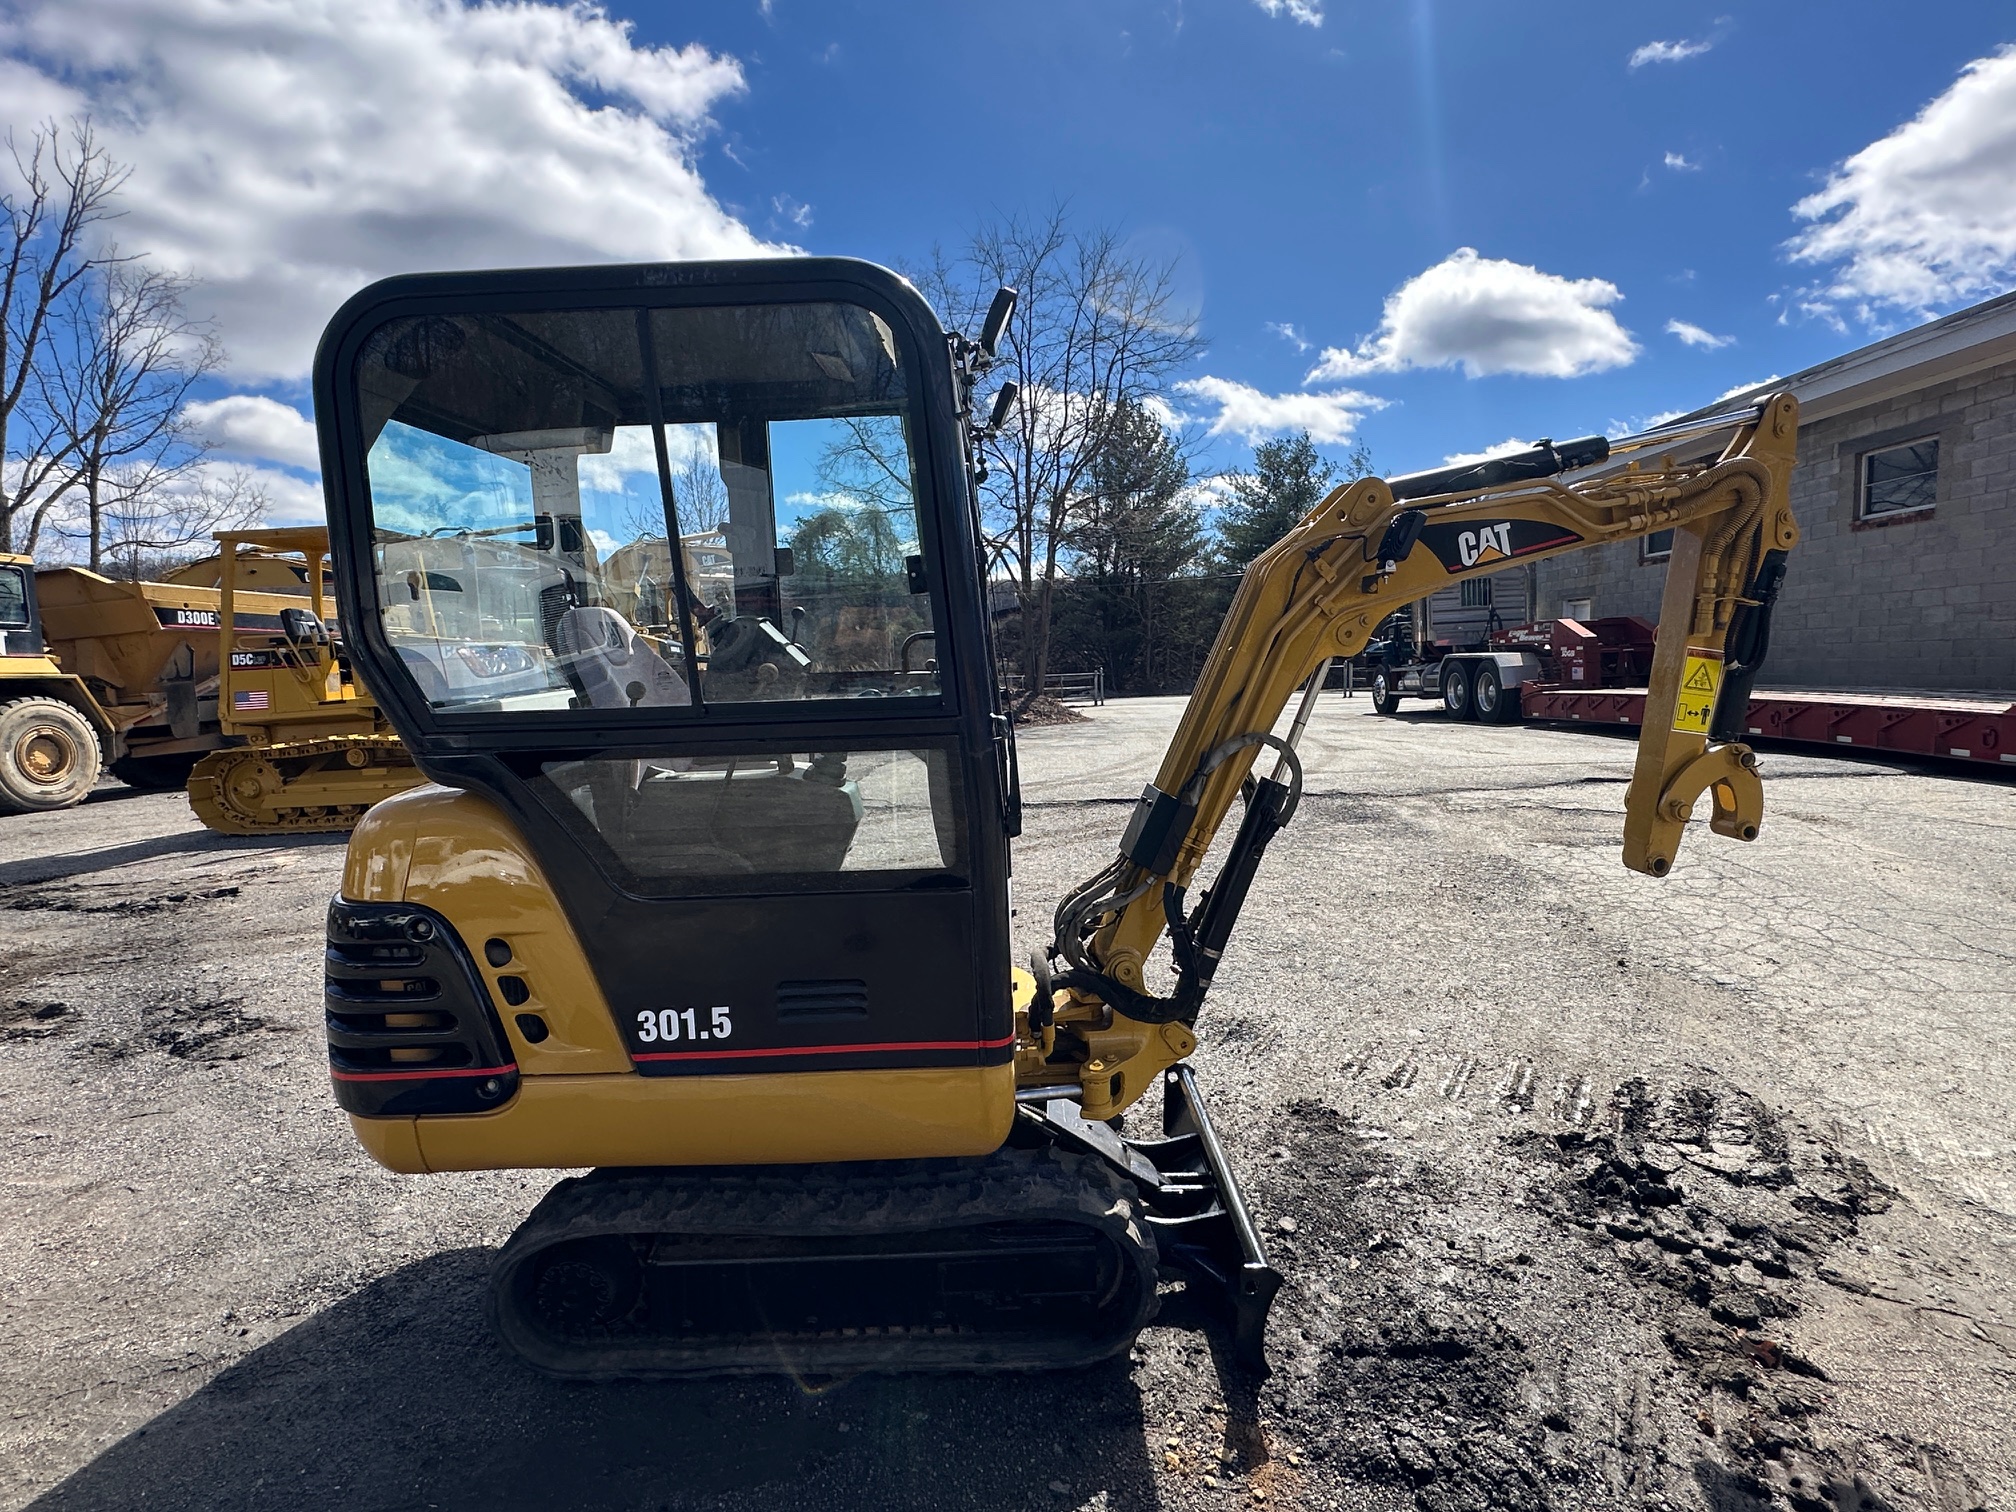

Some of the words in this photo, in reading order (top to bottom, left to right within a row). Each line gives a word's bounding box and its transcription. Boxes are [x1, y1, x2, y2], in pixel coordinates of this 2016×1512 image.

[1458, 522, 1511, 566] CAT
[702, 554, 715, 567] CAT
[177, 610, 216, 625] D300E
[232, 653, 254, 666] D5C
[637, 1006, 732, 1042] 301.5
